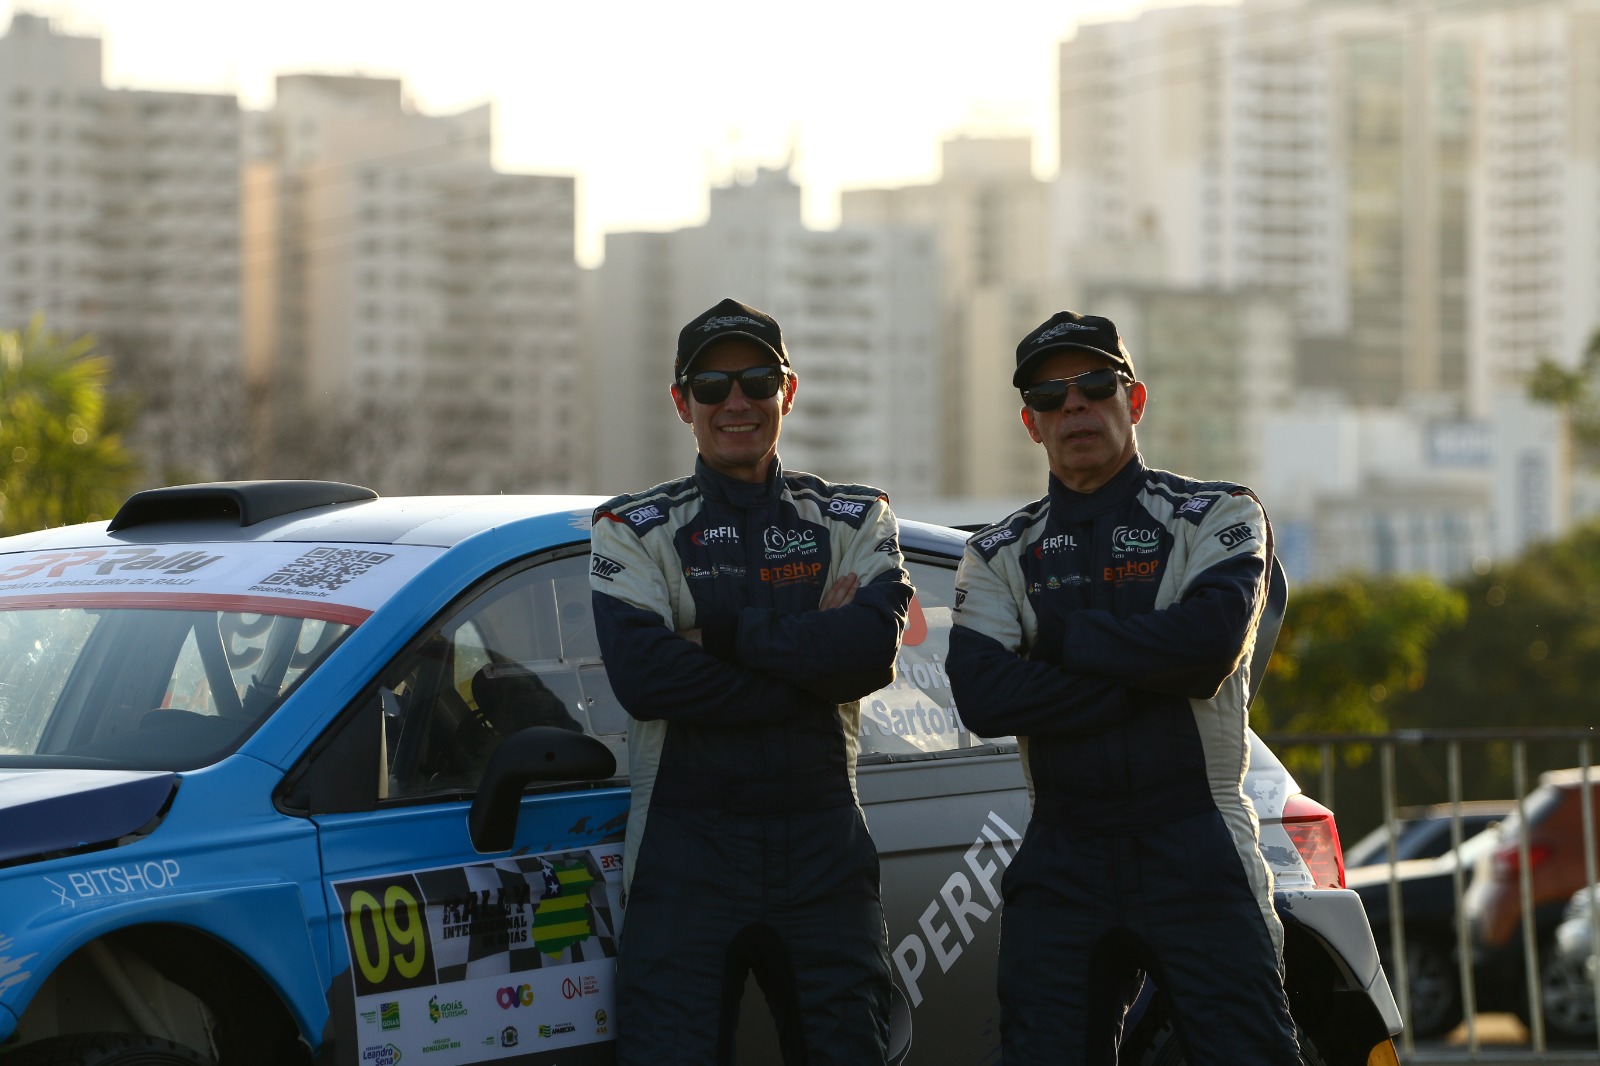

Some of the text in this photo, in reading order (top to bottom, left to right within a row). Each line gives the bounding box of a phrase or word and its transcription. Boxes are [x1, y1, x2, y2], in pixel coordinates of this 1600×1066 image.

[830, 501, 864, 514] OMP
[1179, 499, 1209, 511] OMP
[630, 507, 659, 523] OMP
[981, 530, 1013, 549] OMP
[1219, 526, 1252, 547] OMP
[94, 548, 225, 575] Rally
[592, 556, 621, 577] OMP
[151, 578, 200, 586] RALLY
[870, 699, 966, 737] Sartori
[68, 859, 180, 897] BITSHOP
[443, 884, 530, 924] RALLY
[349, 885, 425, 984] 09
[443, 915, 527, 939] INTERNACIONAL
[440, 1000, 463, 1011] GOIÁS
[441, 1009, 469, 1019] TURISMO
[551, 1025, 576, 1035] APARECIDA
[363, 1047, 393, 1060] Leandro
[422, 1044, 449, 1053] RONILSON
[375, 1057, 393, 1066] Sena
